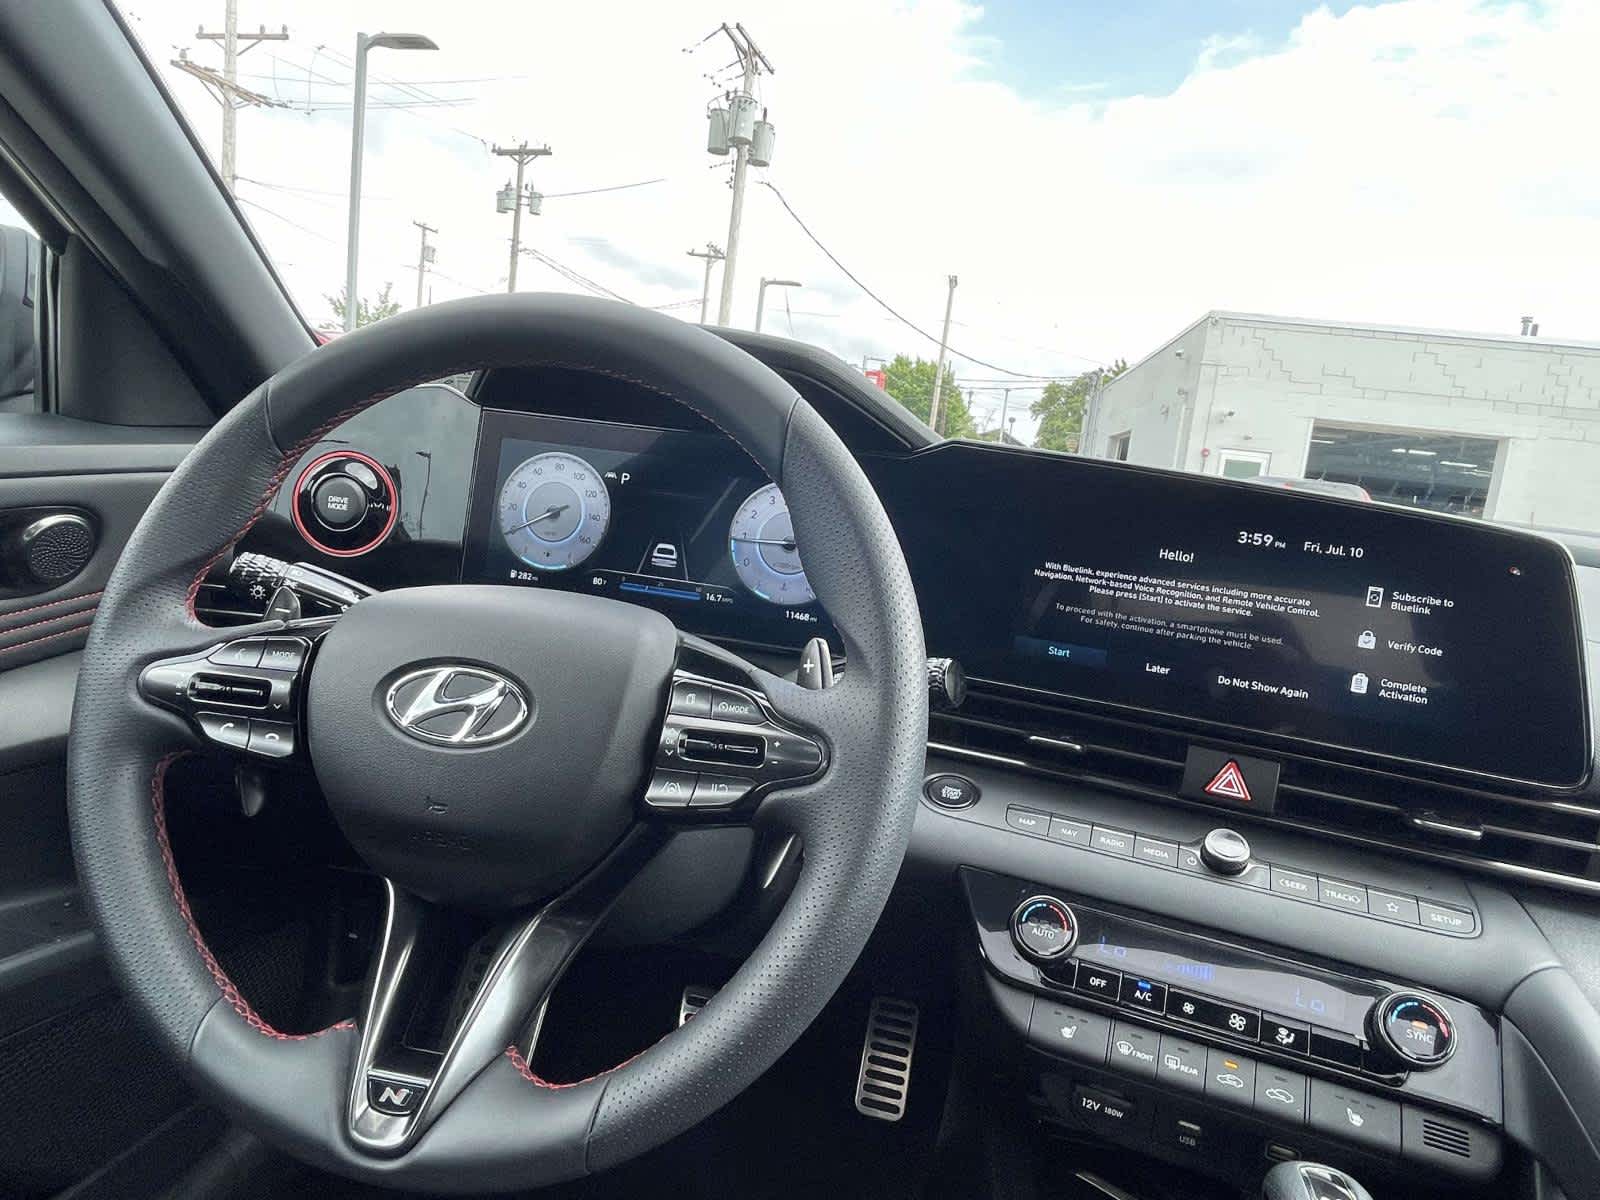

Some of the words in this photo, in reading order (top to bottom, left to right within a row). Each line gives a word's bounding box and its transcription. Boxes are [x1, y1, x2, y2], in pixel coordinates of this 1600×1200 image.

[620, 473, 631, 485] P
[327, 494, 349, 504] DRIVE
[769, 495, 776, 505] 3
[327, 502, 348, 511] MODE
[751, 510, 758, 519] 2
[1237, 531, 1274, 547] 3:59
[1274, 540, 1286, 549] PM
[1325, 544, 1346, 557] Jul.
[1349, 546, 1364, 559] 10
[1159, 548, 1194, 563] Hello!
[1045, 561, 1062, 570] With
[1096, 570, 1137, 582] experience
[1139, 574, 1175, 587] advanced
[1177, 581, 1210, 592] services
[1212, 584, 1248, 598] including
[1250, 592, 1273, 601] more
[1274, 595, 1311, 606] accurate
[1076, 575, 1133, 590] Network-based
[1134, 583, 1155, 593] Voice
[1205, 594, 1221, 603] and
[1222, 596, 1254, 607] Remote
[1255, 600, 1285, 612] Vehicle
[1287, 605, 1320, 618] Control.
[1089, 585, 1114, 596] Please
[1115, 589, 1137, 600] press
[1165, 596, 1173, 605] to
[1174, 599, 1205, 610] activate
[1207, 603, 1220, 612] the
[1222, 605, 1253, 617] service.
[1391, 590, 1441, 606] Subscribe
[1443, 597, 1454, 609] to
[1390, 601, 1431, 616] Bluelink
[1056, 602, 1064, 610] To
[1066, 605, 1096, 616] proceed
[1097, 609, 1113, 618] with
[1115, 612, 1127, 621] the
[1176, 623, 1225, 637] smartphone
[1226, 629, 1247, 639] must
[1249, 633, 1259, 641] be
[1080, 615, 1093, 624] For
[1121, 622, 1154, 634] continue
[1155, 625, 1174, 637] after
[1176, 630, 1207, 643] parking
[1208, 635, 1221, 644] the
[1048, 645, 1071, 658] Start
[1387, 639, 1417, 655] Verify
[1418, 644, 1443, 657] Code
[1145, 662, 1170, 675] Later
[1217, 675, 1231, 686] Do
[1232, 677, 1249, 690] Not
[1250, 679, 1279, 695] Show
[1280, 686, 1309, 700] Again
[1380, 678, 1427, 695] Complete
[1378, 689, 1428, 706] Activation
[728, 705, 749, 714] MODE
[1061, 828, 1078, 838] NAV
[1099, 836, 1125, 849] RADIO
[1143, 846, 1169, 859] MEDIA
[1430, 912, 1462, 927] SETUP
[1031, 926, 1055, 940] AUTO
[1089, 976, 1107, 989] OFF
[1134, 989, 1153, 1002] A/C
[1405, 1029, 1433, 1044] SYNC
[1131, 1049, 1154, 1063] FRONT
[1180, 1064, 1199, 1076] REAR
[1081, 1097, 1101, 1111] 12V
[1179, 1135, 1196, 1146] USB
